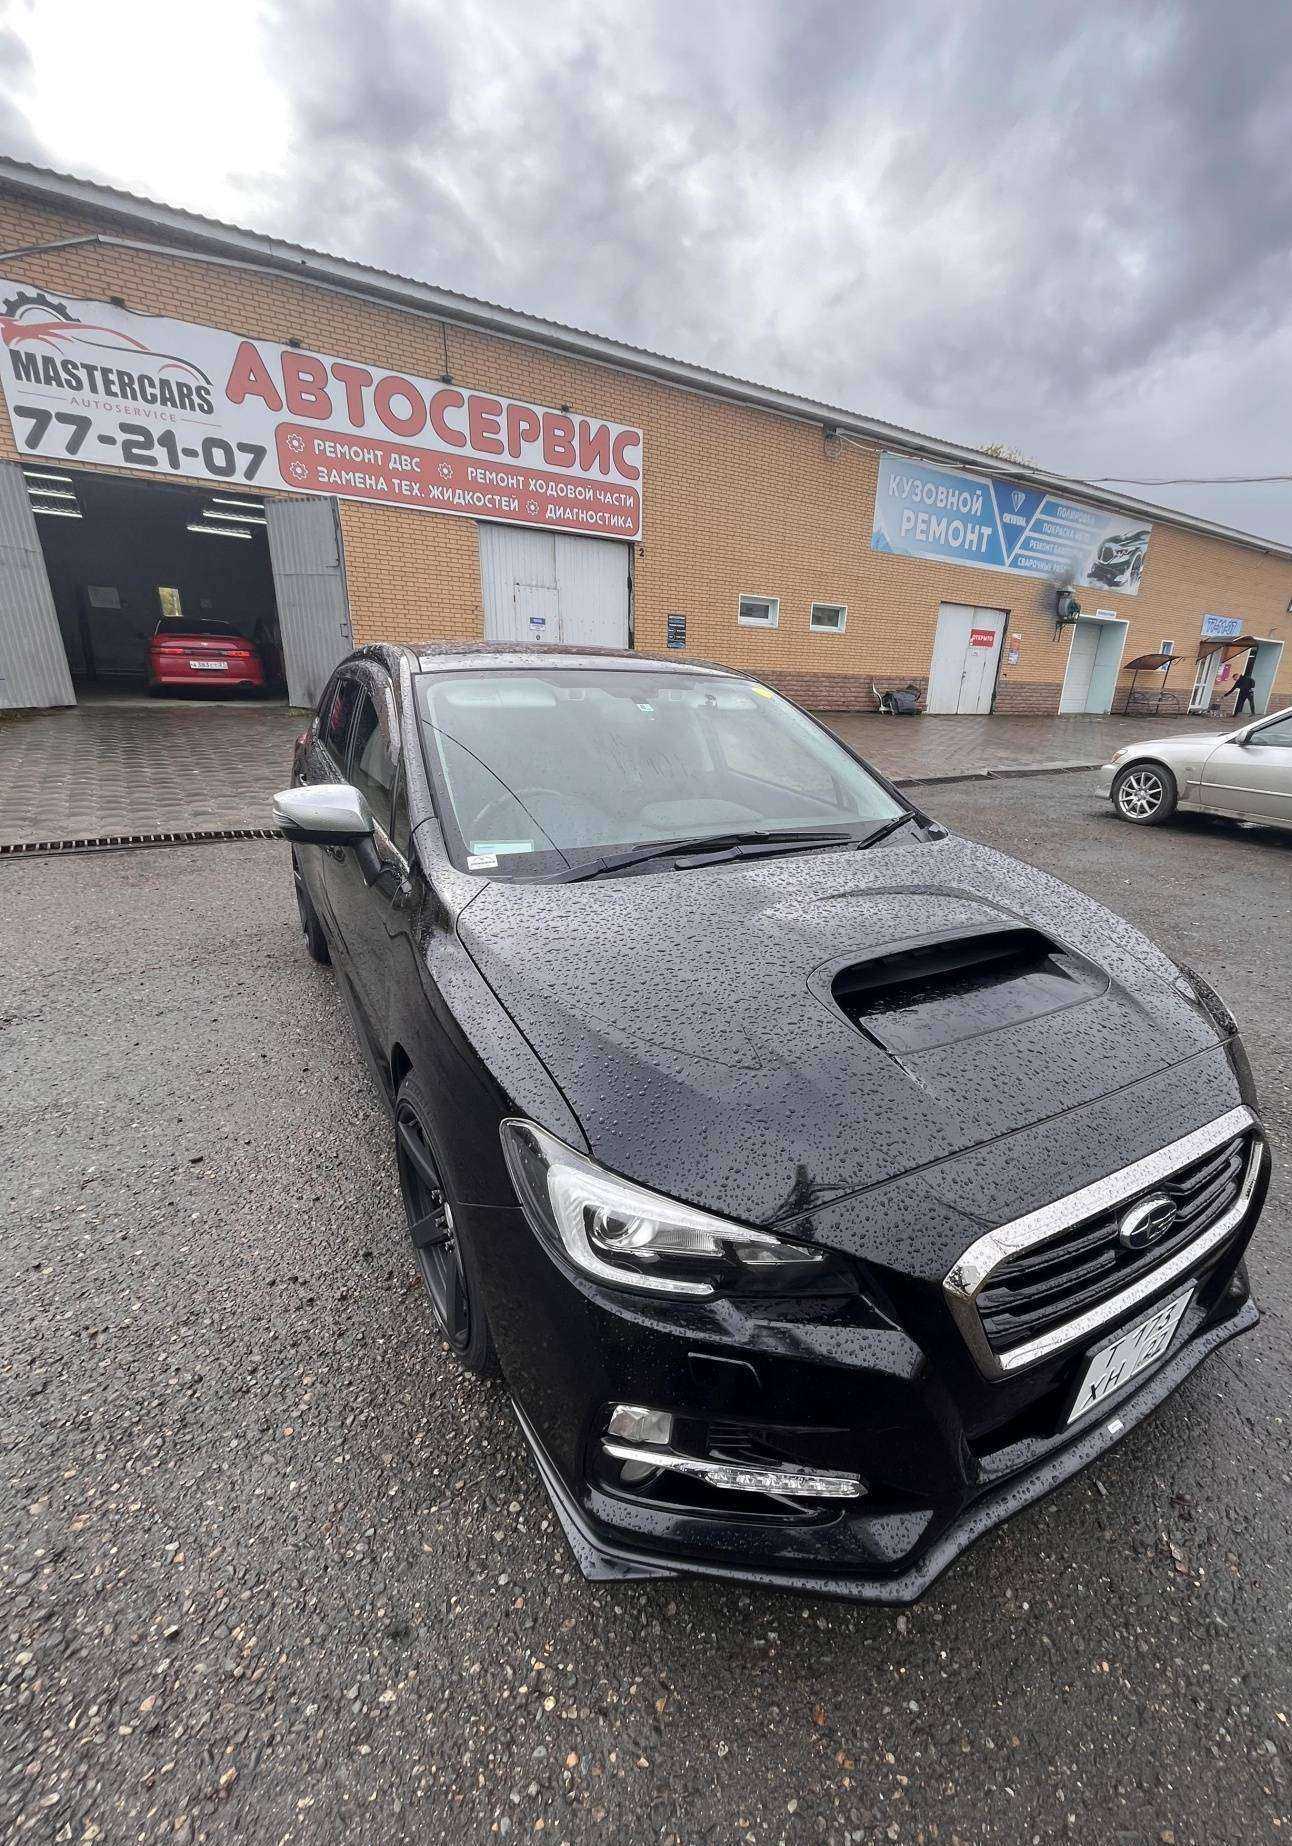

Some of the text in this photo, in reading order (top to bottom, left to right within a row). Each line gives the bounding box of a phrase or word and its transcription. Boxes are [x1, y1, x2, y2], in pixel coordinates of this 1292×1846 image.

[9, 348, 214, 415] MASTERCARS
[70, 396, 177, 423] AUTOSERVICE
[225, 340, 641, 481] АВТОСЕРВИС
[13, 404, 267, 482] 77-21-07
[313, 439, 421, 473] РЕМОНТ ДВС
[317, 466, 519, 512] ЗАМЕНА ТЕХ. ЖИДКОСТЕЙ
[467, 467, 634, 508] РЕМОНТ ХОДОВОЙ ЧАСТИ
[888, 472, 983, 517] КУЗОВНОЙ
[545, 503, 634, 530] ДИАГНОСТИКА
[901, 508, 993, 553] РЕМОНТ
[971, 634, 994, 642] ОТКРЫТО
